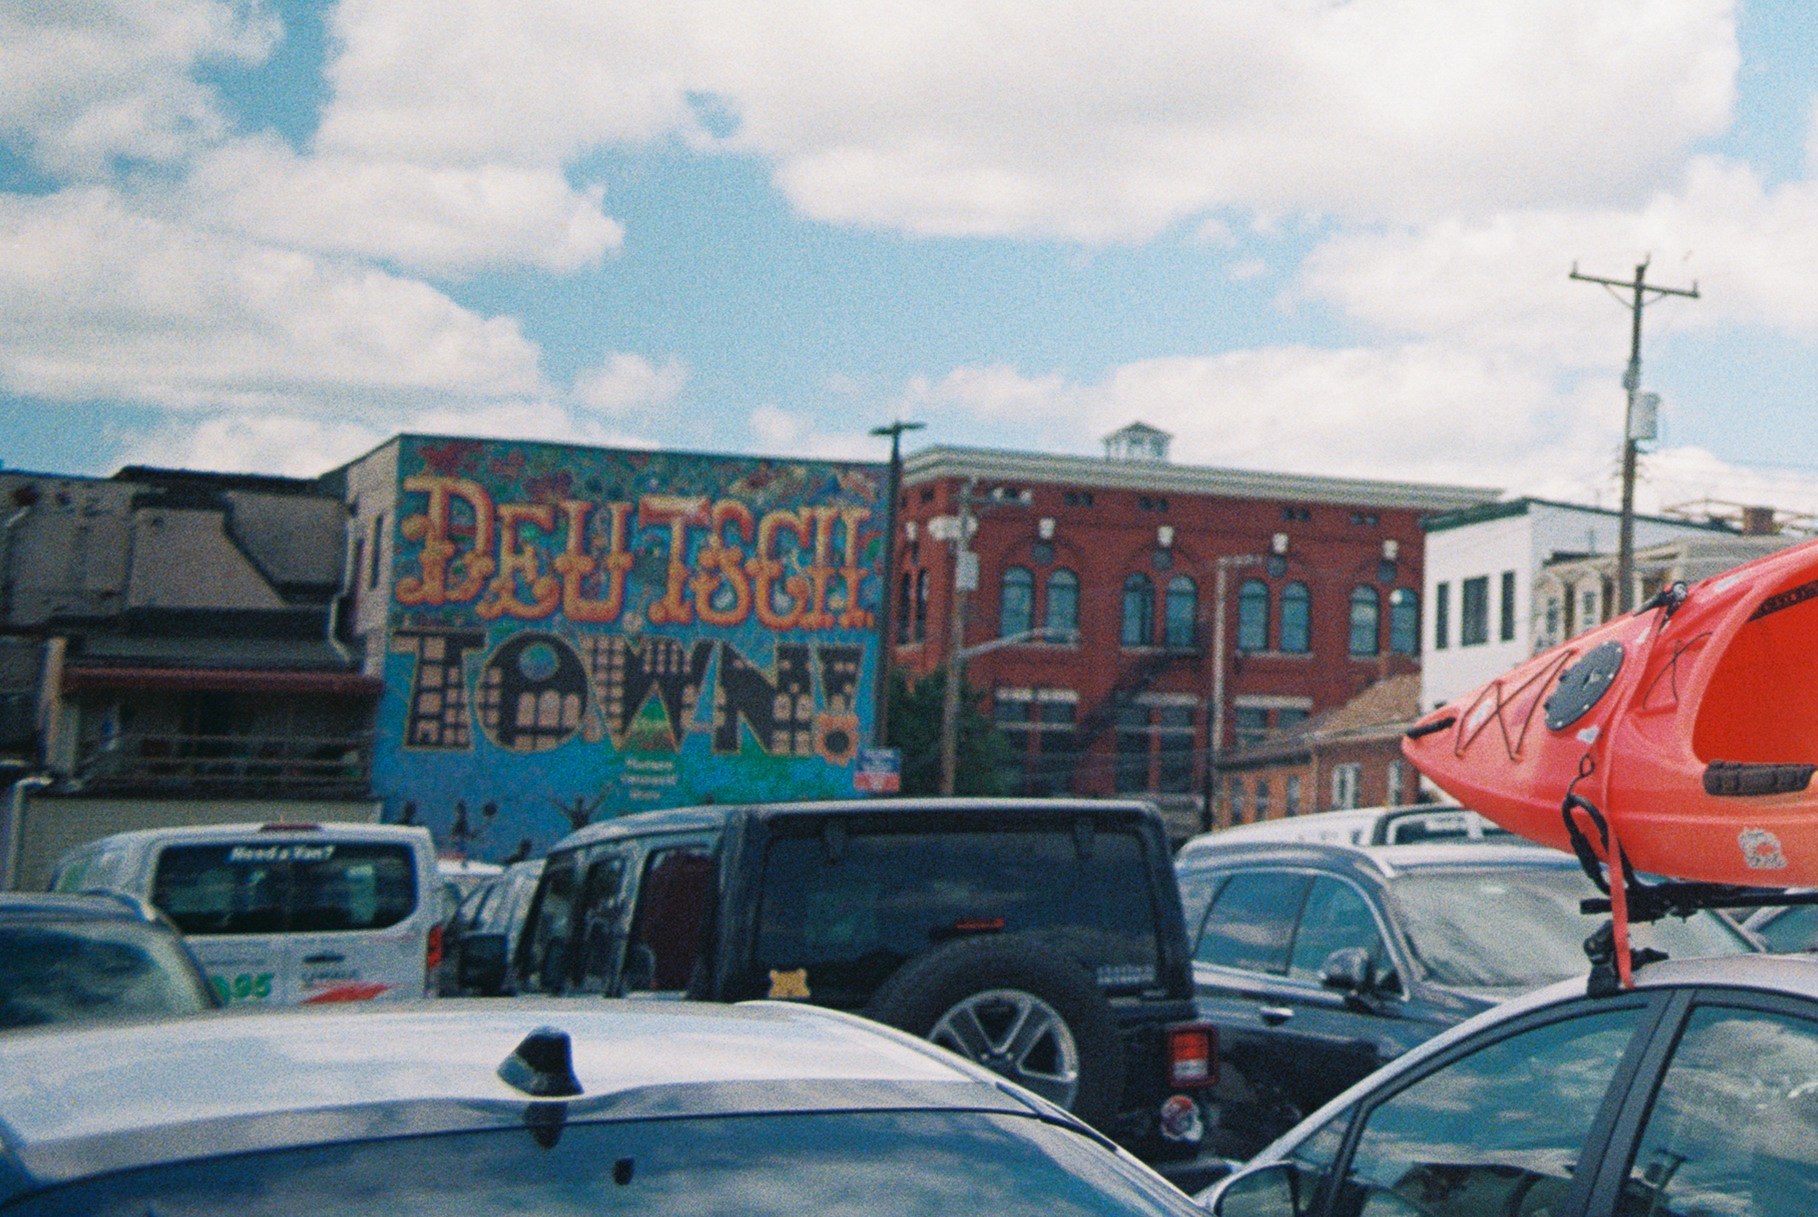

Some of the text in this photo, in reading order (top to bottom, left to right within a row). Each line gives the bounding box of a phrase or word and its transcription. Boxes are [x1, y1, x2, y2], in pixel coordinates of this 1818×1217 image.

[395, 475, 876, 631] DEUTSCH
[388, 626, 866, 768] TOWN!
[230, 845, 279, 861] Need
